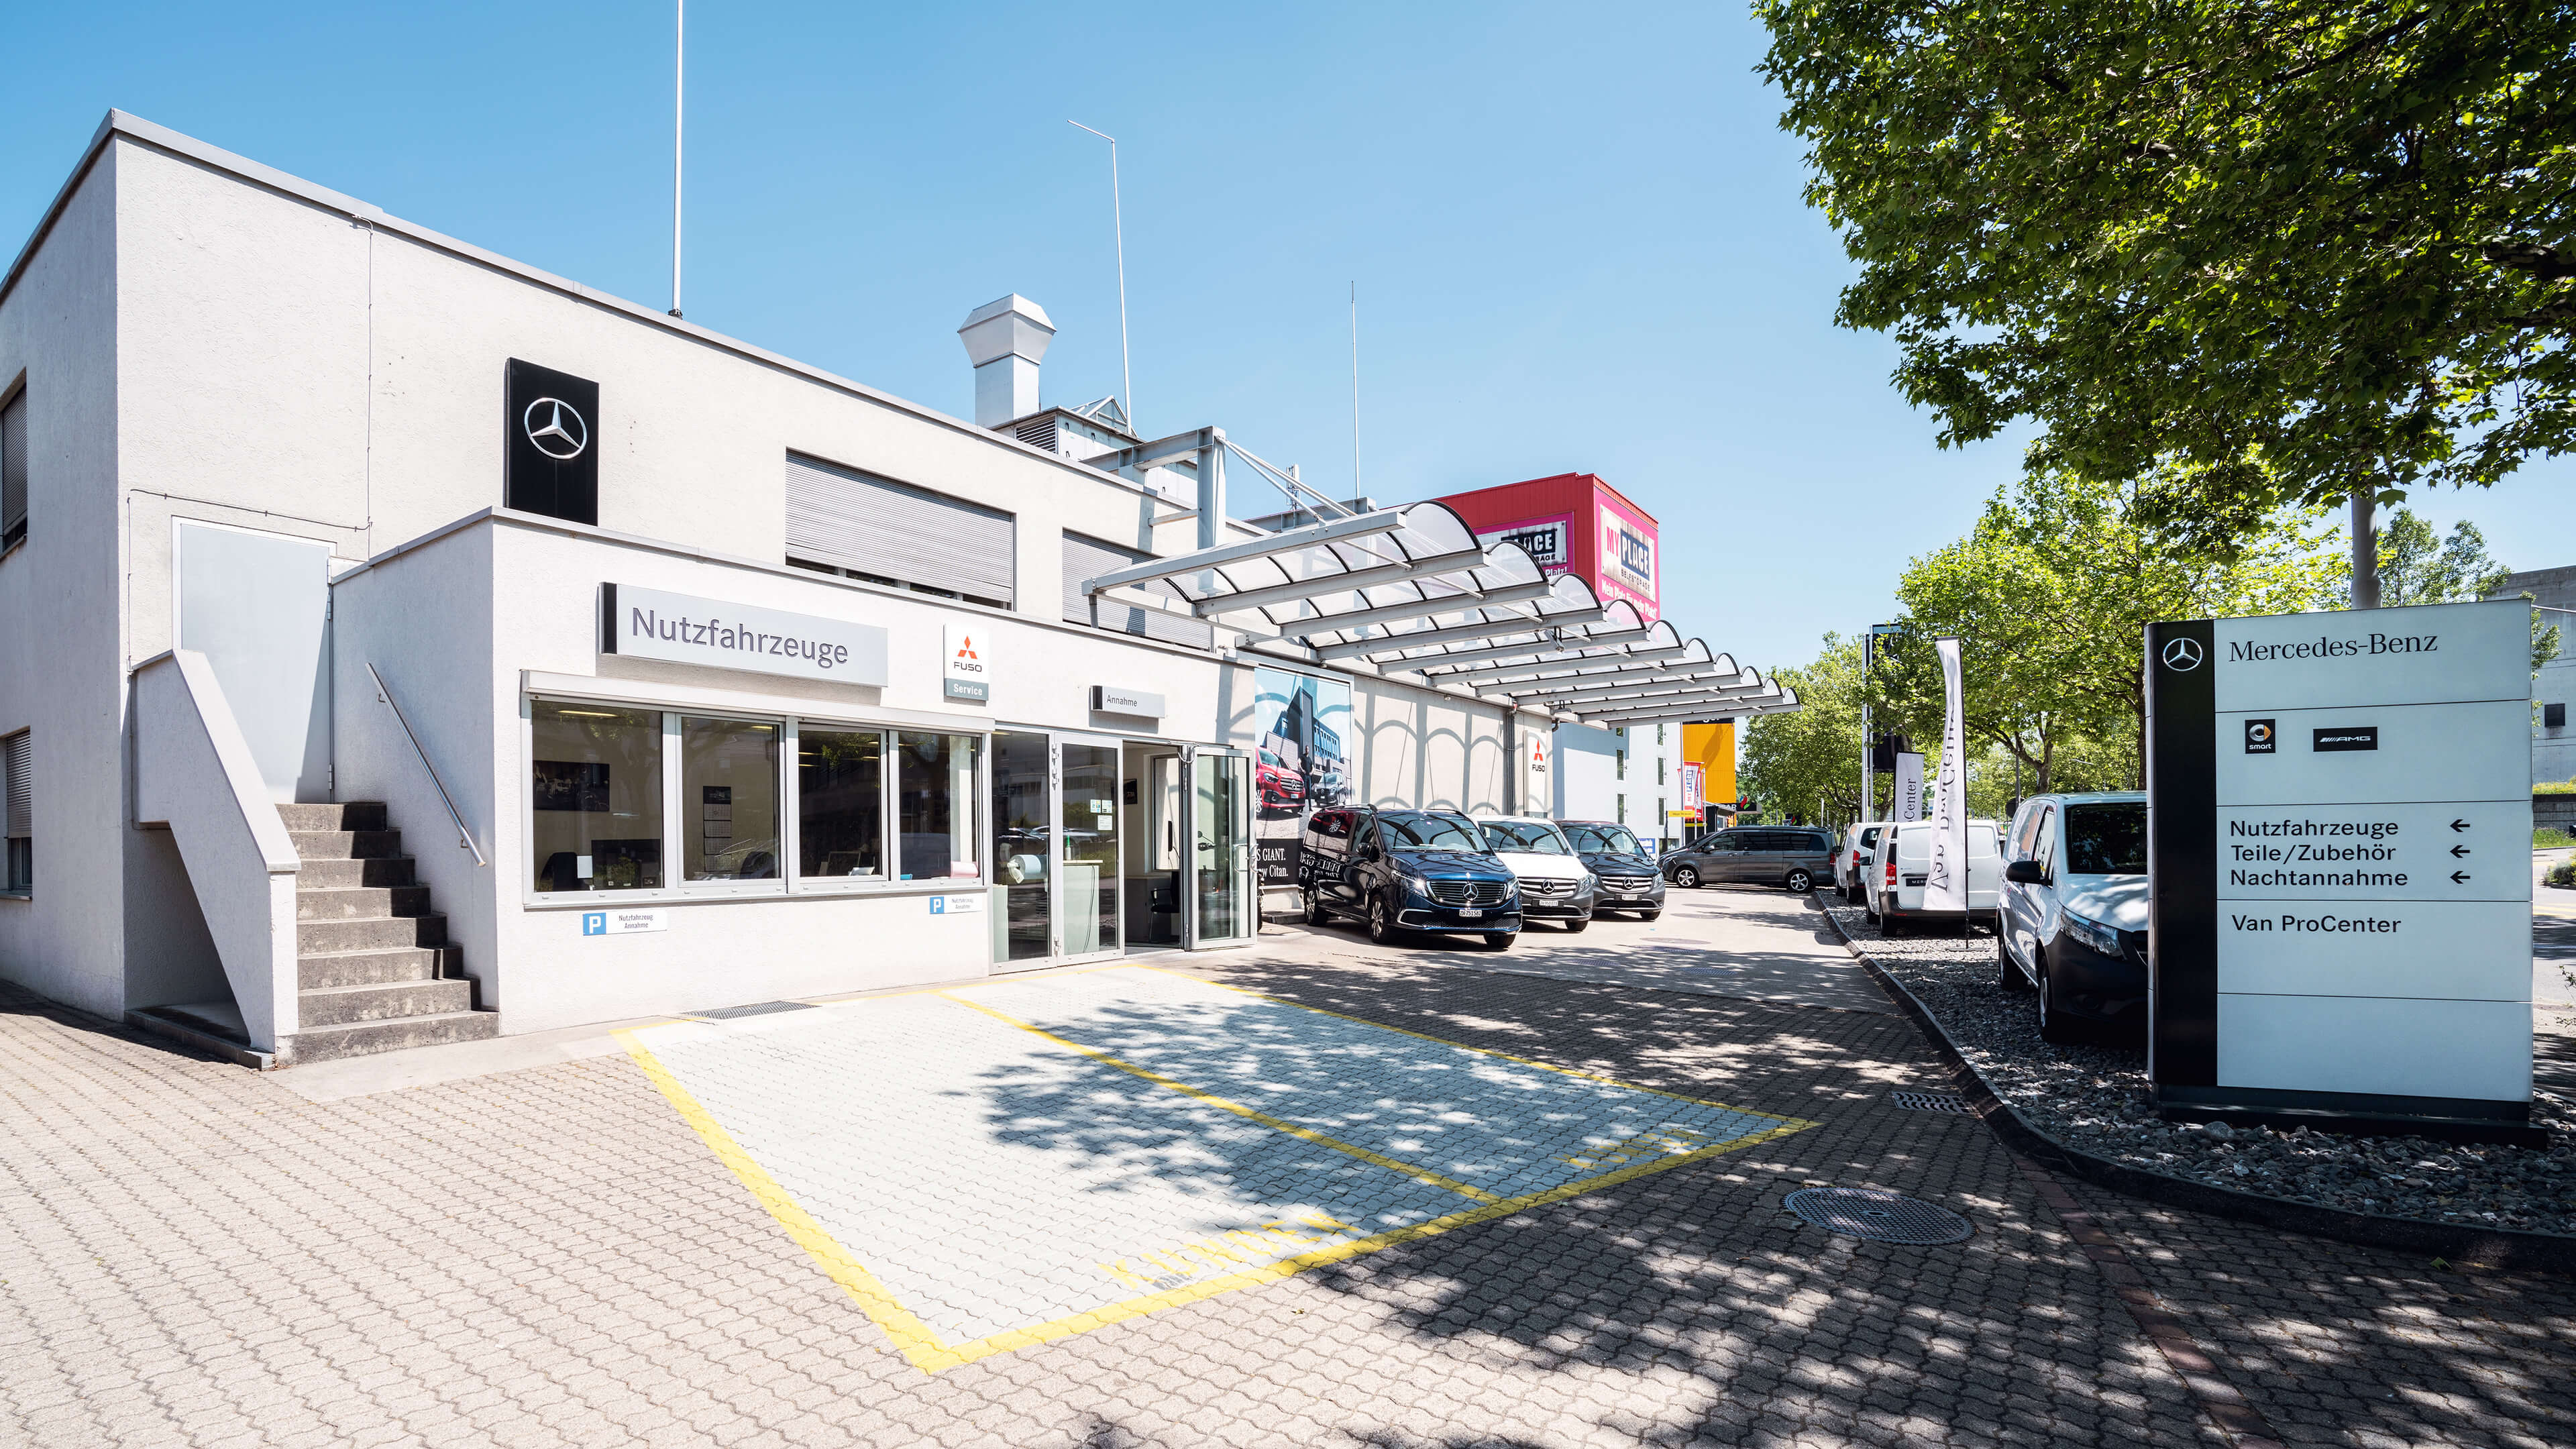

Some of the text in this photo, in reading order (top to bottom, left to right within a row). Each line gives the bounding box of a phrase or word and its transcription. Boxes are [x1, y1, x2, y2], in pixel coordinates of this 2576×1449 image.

[1607, 526, 1649, 575] MY PLACE
[633, 607, 848, 669] Nutzfahrzeuge
[2229, 633, 2438, 661] Mercedes-Benz
[954, 661, 982, 672] FUSO
[953, 684, 983, 696] Service
[1106, 694, 1138, 707] Annahme
[1532, 764, 1546, 772] FUSO
[1904, 778, 1917, 822] Center
[2231, 820, 2399, 839] Nutzfahrzeuge
[1263, 848, 1286, 861] GIANT.
[2231, 844, 2396, 865] Teile/Zubehör
[1269, 864, 1289, 877] Citan.
[2231, 869, 2408, 885] Nachtannahme
[589, 916, 601, 934] P
[2232, 915, 2402, 932] Van ProCenter
